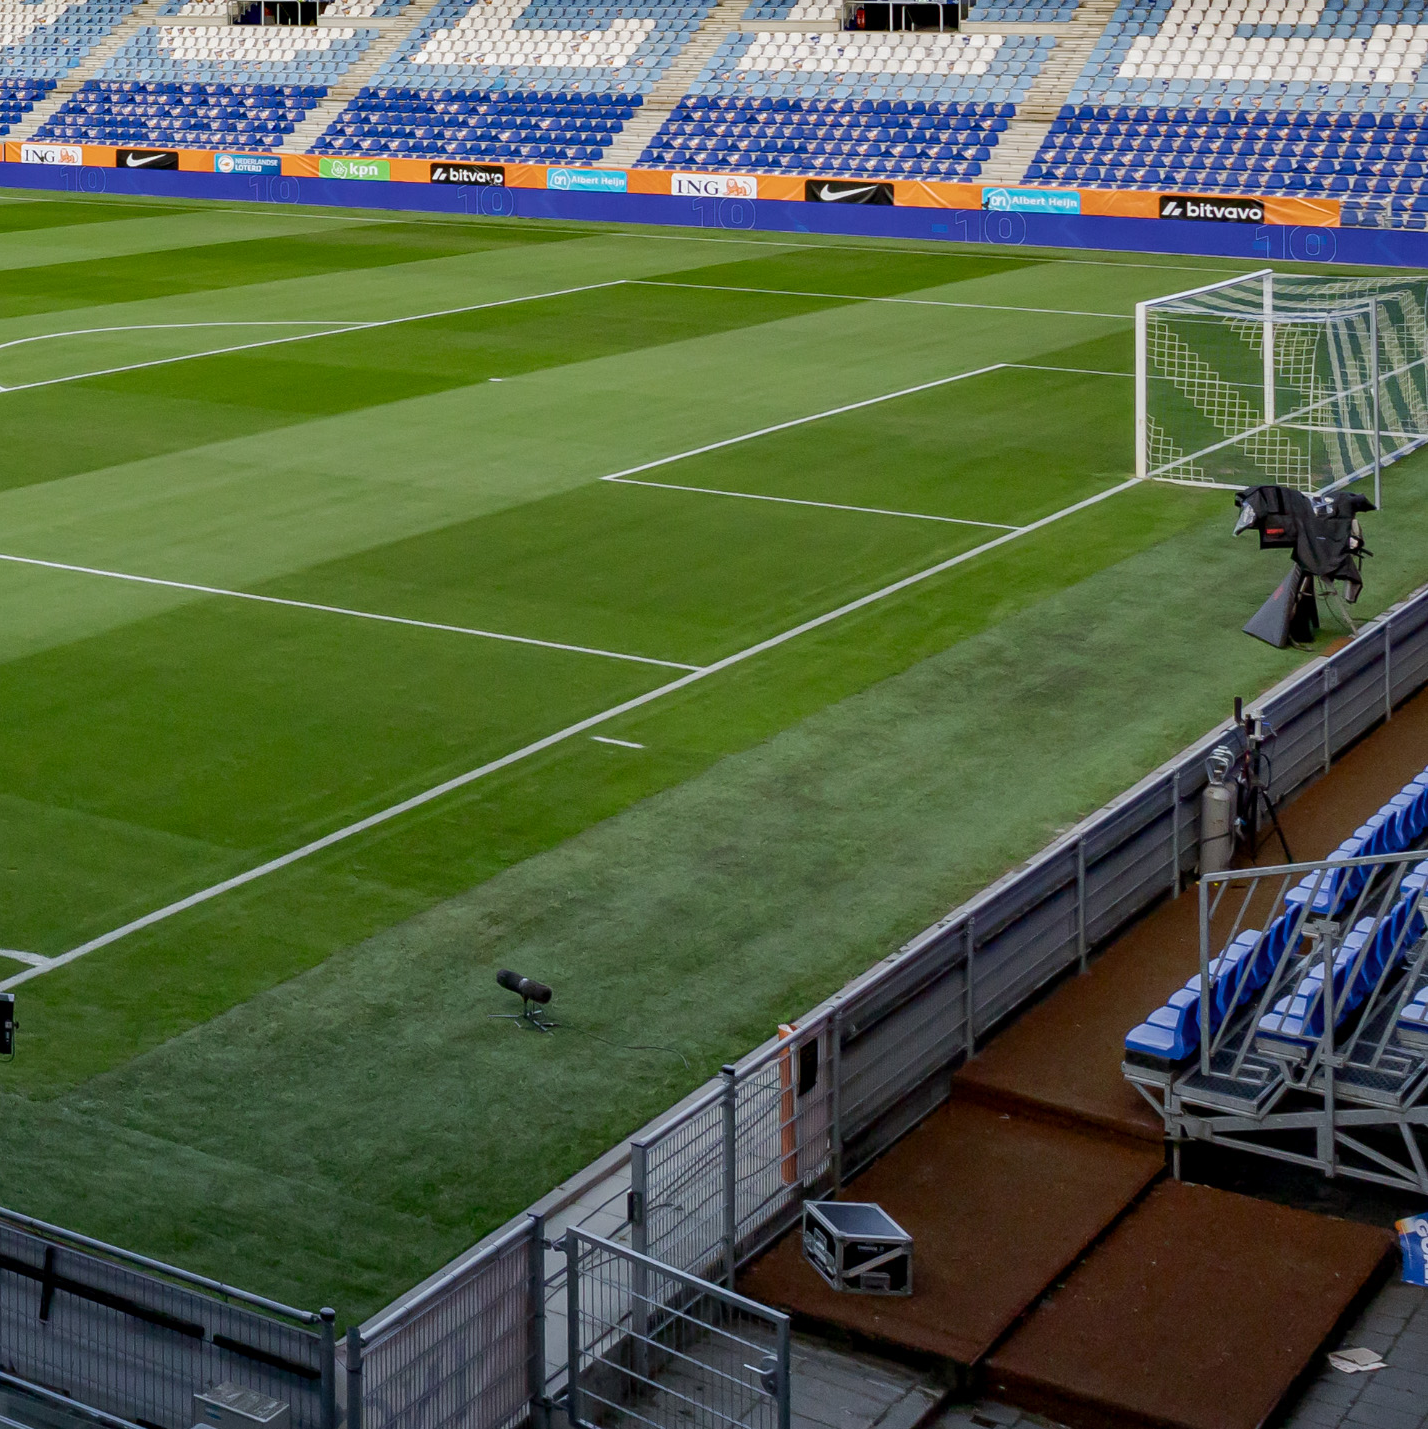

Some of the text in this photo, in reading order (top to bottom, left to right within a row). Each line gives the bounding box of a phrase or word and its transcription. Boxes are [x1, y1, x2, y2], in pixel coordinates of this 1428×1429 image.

[24, 149, 56, 163] ING
[234, 157, 279, 167] NEDERLANDSE
[234, 164, 263, 173] LOTERIJ
[349, 161, 379, 178] kpn
[450, 168, 504, 184] bitvavo
[59, 166, 106, 194] 10
[571, 175, 600, 185] Albert
[601, 177, 625, 188] Heijn
[677, 179, 720, 196] ING
[248, 175, 300, 203] 10
[457, 184, 514, 216] 10
[1011, 196, 1047, 206] Albert
[1048, 196, 1078, 209] Heijn
[692, 196, 756, 230] 10
[1186, 202, 1262, 221] bitvavo
[955, 209, 1026, 246] 10
[1255, 223, 1336, 262] 10
